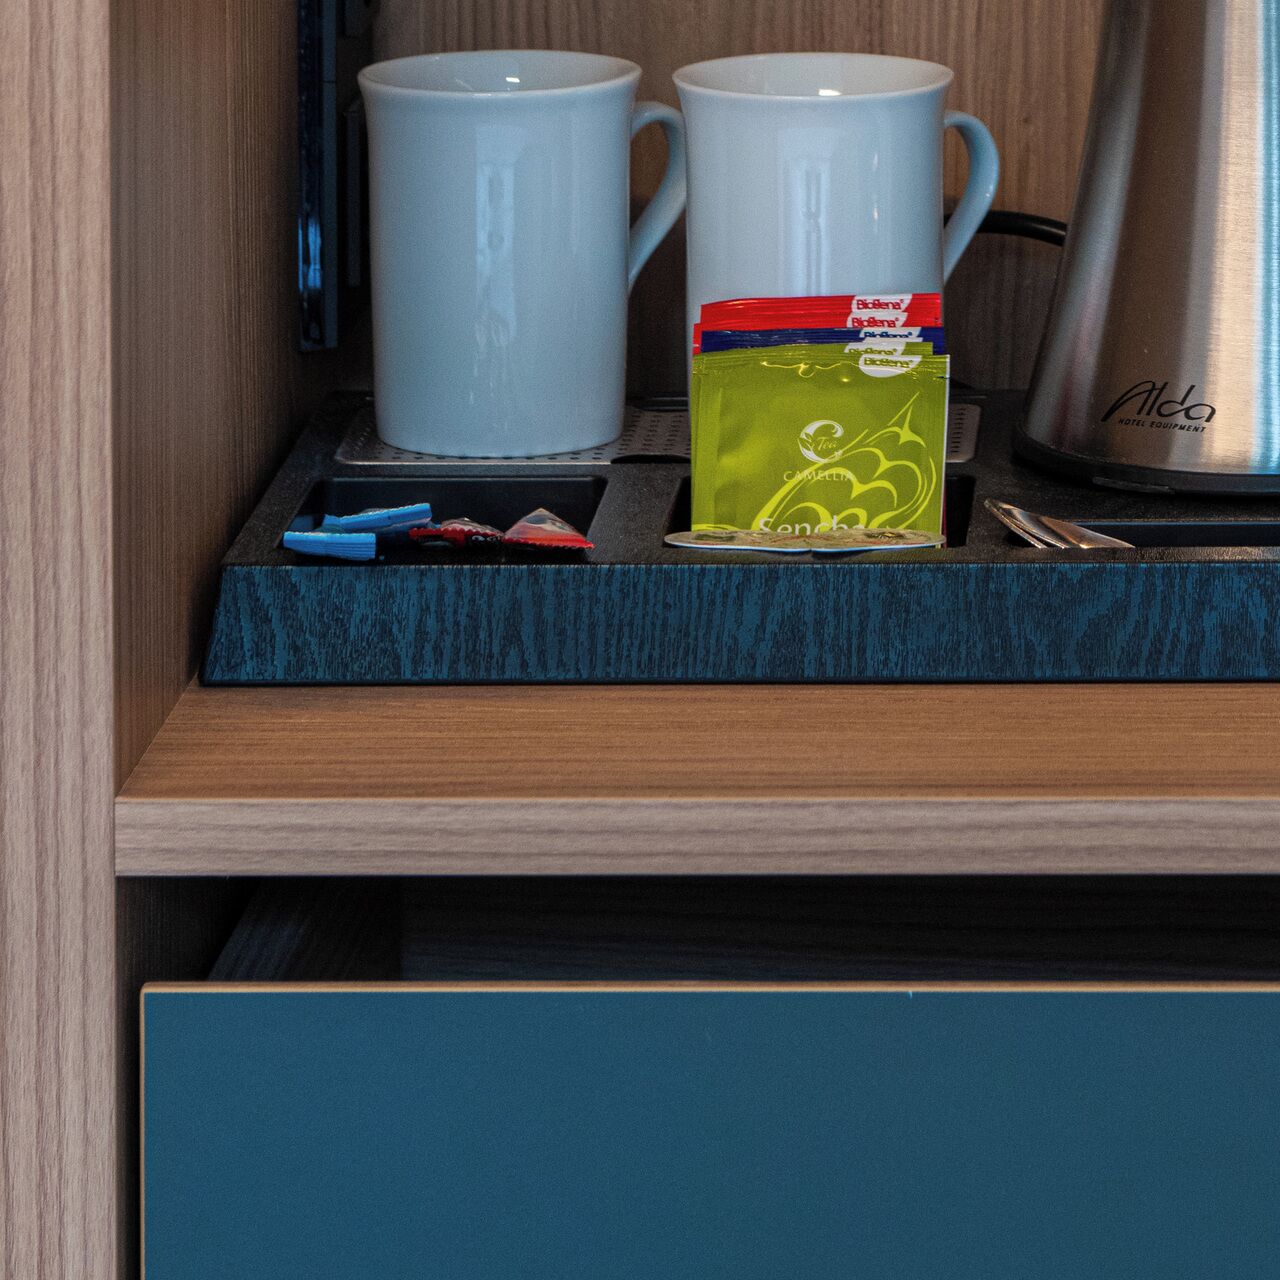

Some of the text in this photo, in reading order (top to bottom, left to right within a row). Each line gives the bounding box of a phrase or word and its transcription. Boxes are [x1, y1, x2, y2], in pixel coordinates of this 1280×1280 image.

[1101, 380, 1217, 422] Alda
[1118, 418, 1207, 433] HOTEL EQUIPMENT
[783, 470, 852, 482] CAMELLIA
[759, 514, 867, 536] Sench
